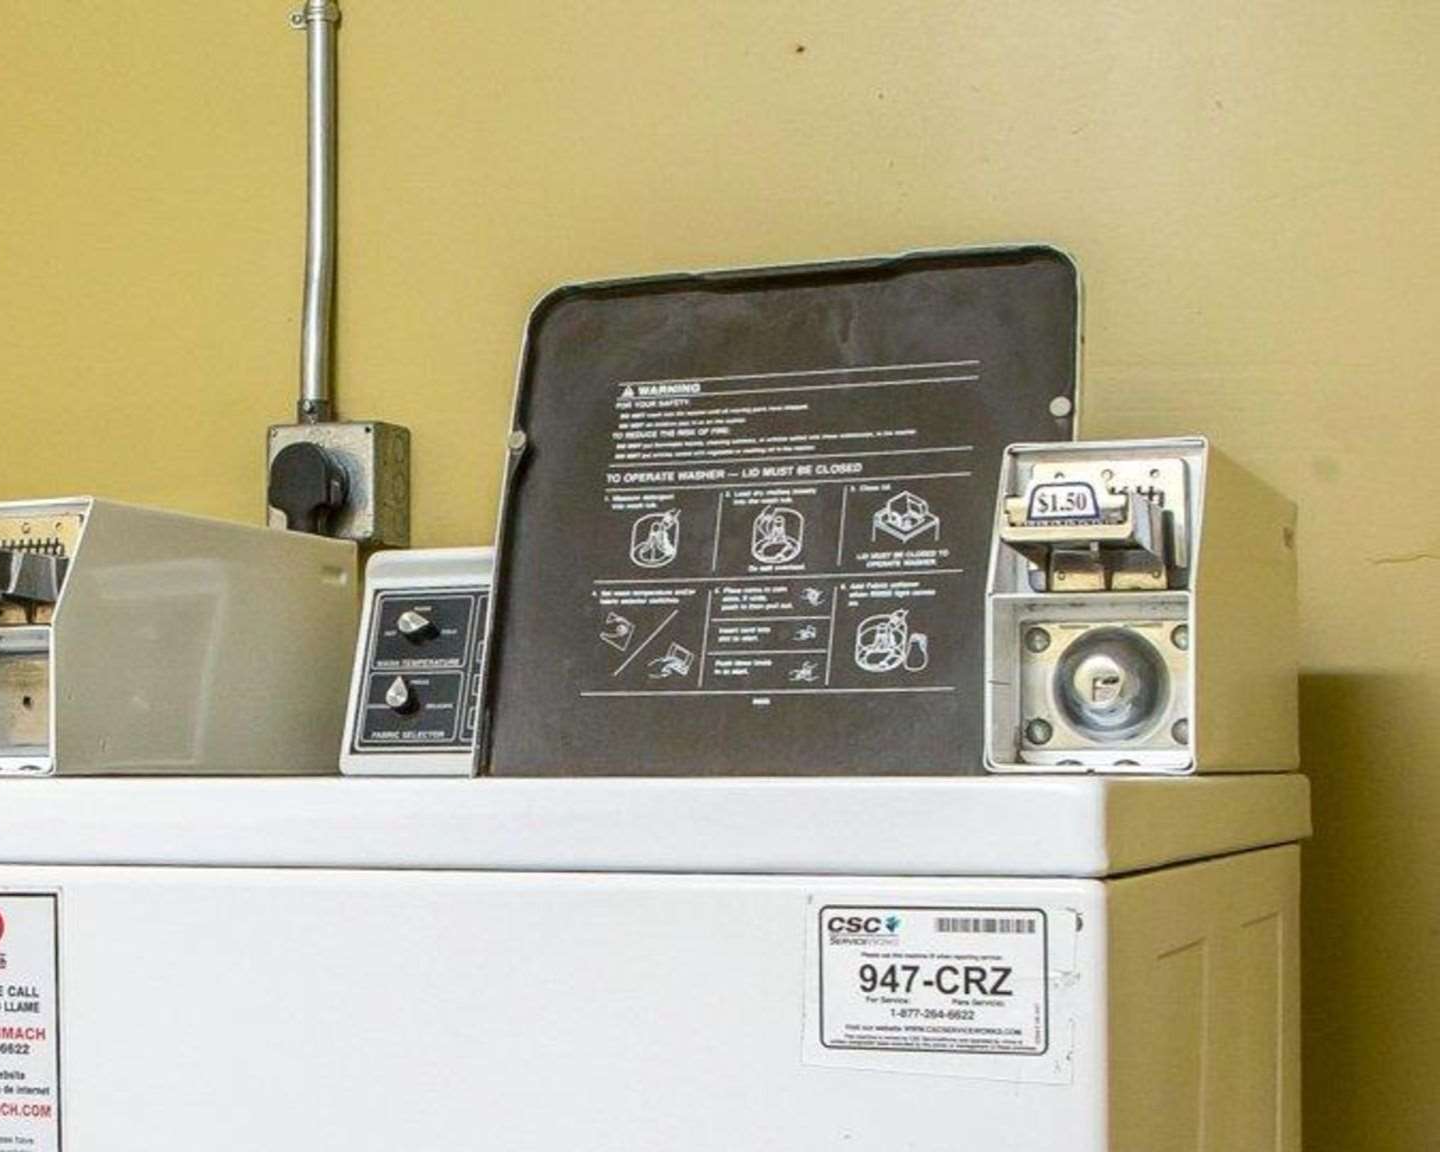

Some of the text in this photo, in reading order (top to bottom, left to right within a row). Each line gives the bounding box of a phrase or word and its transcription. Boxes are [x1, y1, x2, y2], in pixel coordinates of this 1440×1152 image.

[638, 383, 701, 395] WARNING
[698, 428, 709, 436] OF
[606, 473, 622, 484] TO
[624, 471, 674, 483] OPERATE
[677, 469, 725, 481] WASHER
[741, 468, 760, 478] LID
[762, 466, 794, 477] MUST
[796, 464, 812, 476] BE
[815, 462, 862, 475] CLOSED
[1037, 491, 1088, 514] $1.50
[402, 730, 445, 738] SELECTOR
[828, 917, 882, 934] CSC
[859, 964, 1013, 996] 947-CRZ
[8, 986, 39, 998] CALL
[4, 1002, 40, 1013] LLAME
[4, 1085, 14, 1094] de
[16, 1086, 50, 1096] internet
